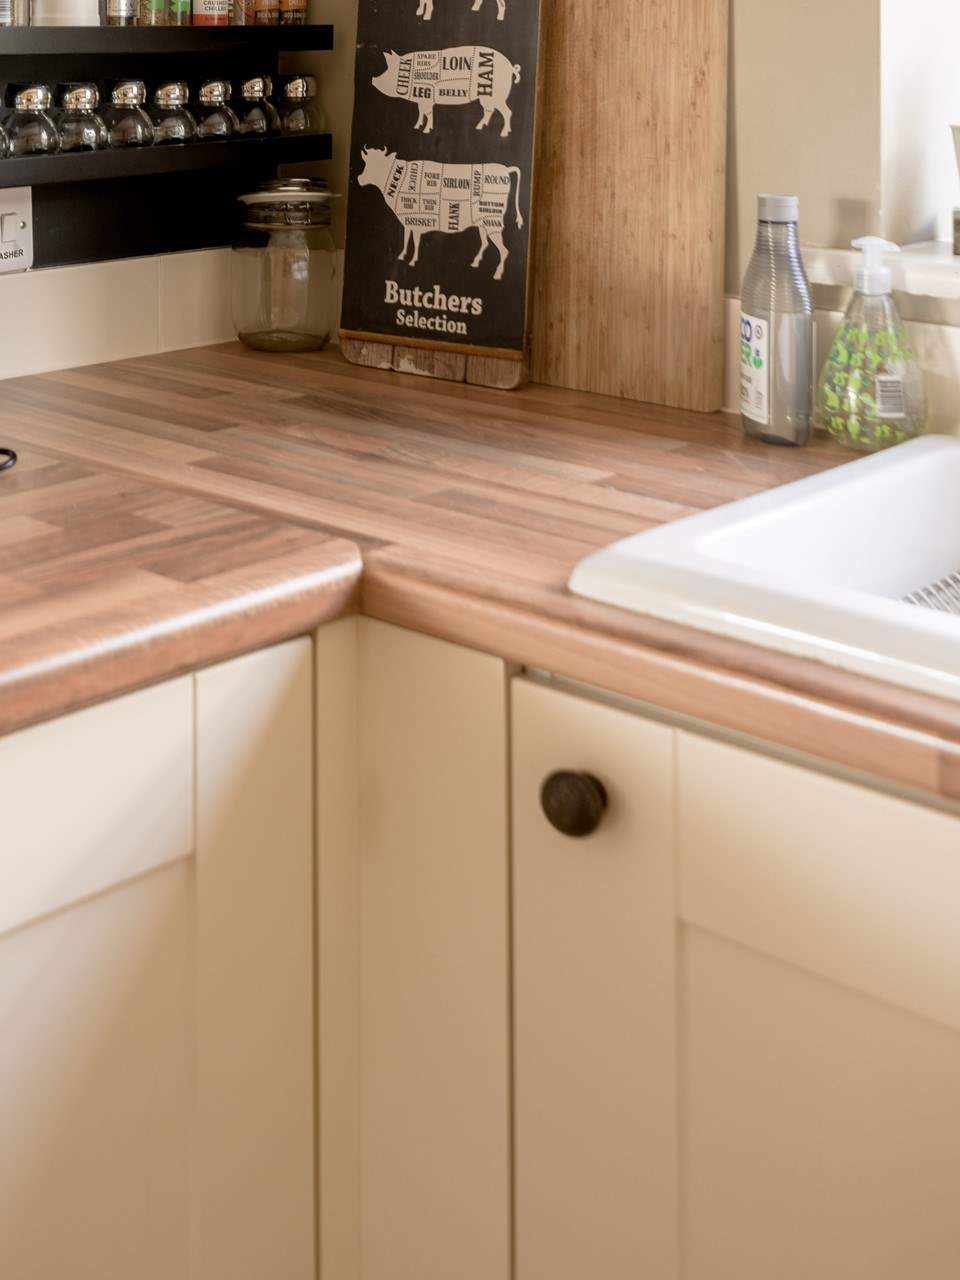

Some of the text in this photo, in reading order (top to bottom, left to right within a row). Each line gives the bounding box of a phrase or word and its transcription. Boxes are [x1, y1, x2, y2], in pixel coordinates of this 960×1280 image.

[395, 58, 413, 96] CHEEK
[442, 56, 471, 71] LOIN
[477, 50, 494, 97] HAM
[412, 86, 432, 99] LEG
[438, 88, 468, 97] BELLY
[387, 164, 405, 198] NECK
[408, 162, 419, 192] CHUCK
[442, 177, 470, 190] SIRLOIN
[472, 170, 481, 197] RUMP
[483, 175, 510, 185] ROUND
[404, 216, 437, 228] BRISKET
[447, 202, 460, 231] FLANK
[384, 279, 484, 317] Butchers
[395, 308, 468, 336] Selection
